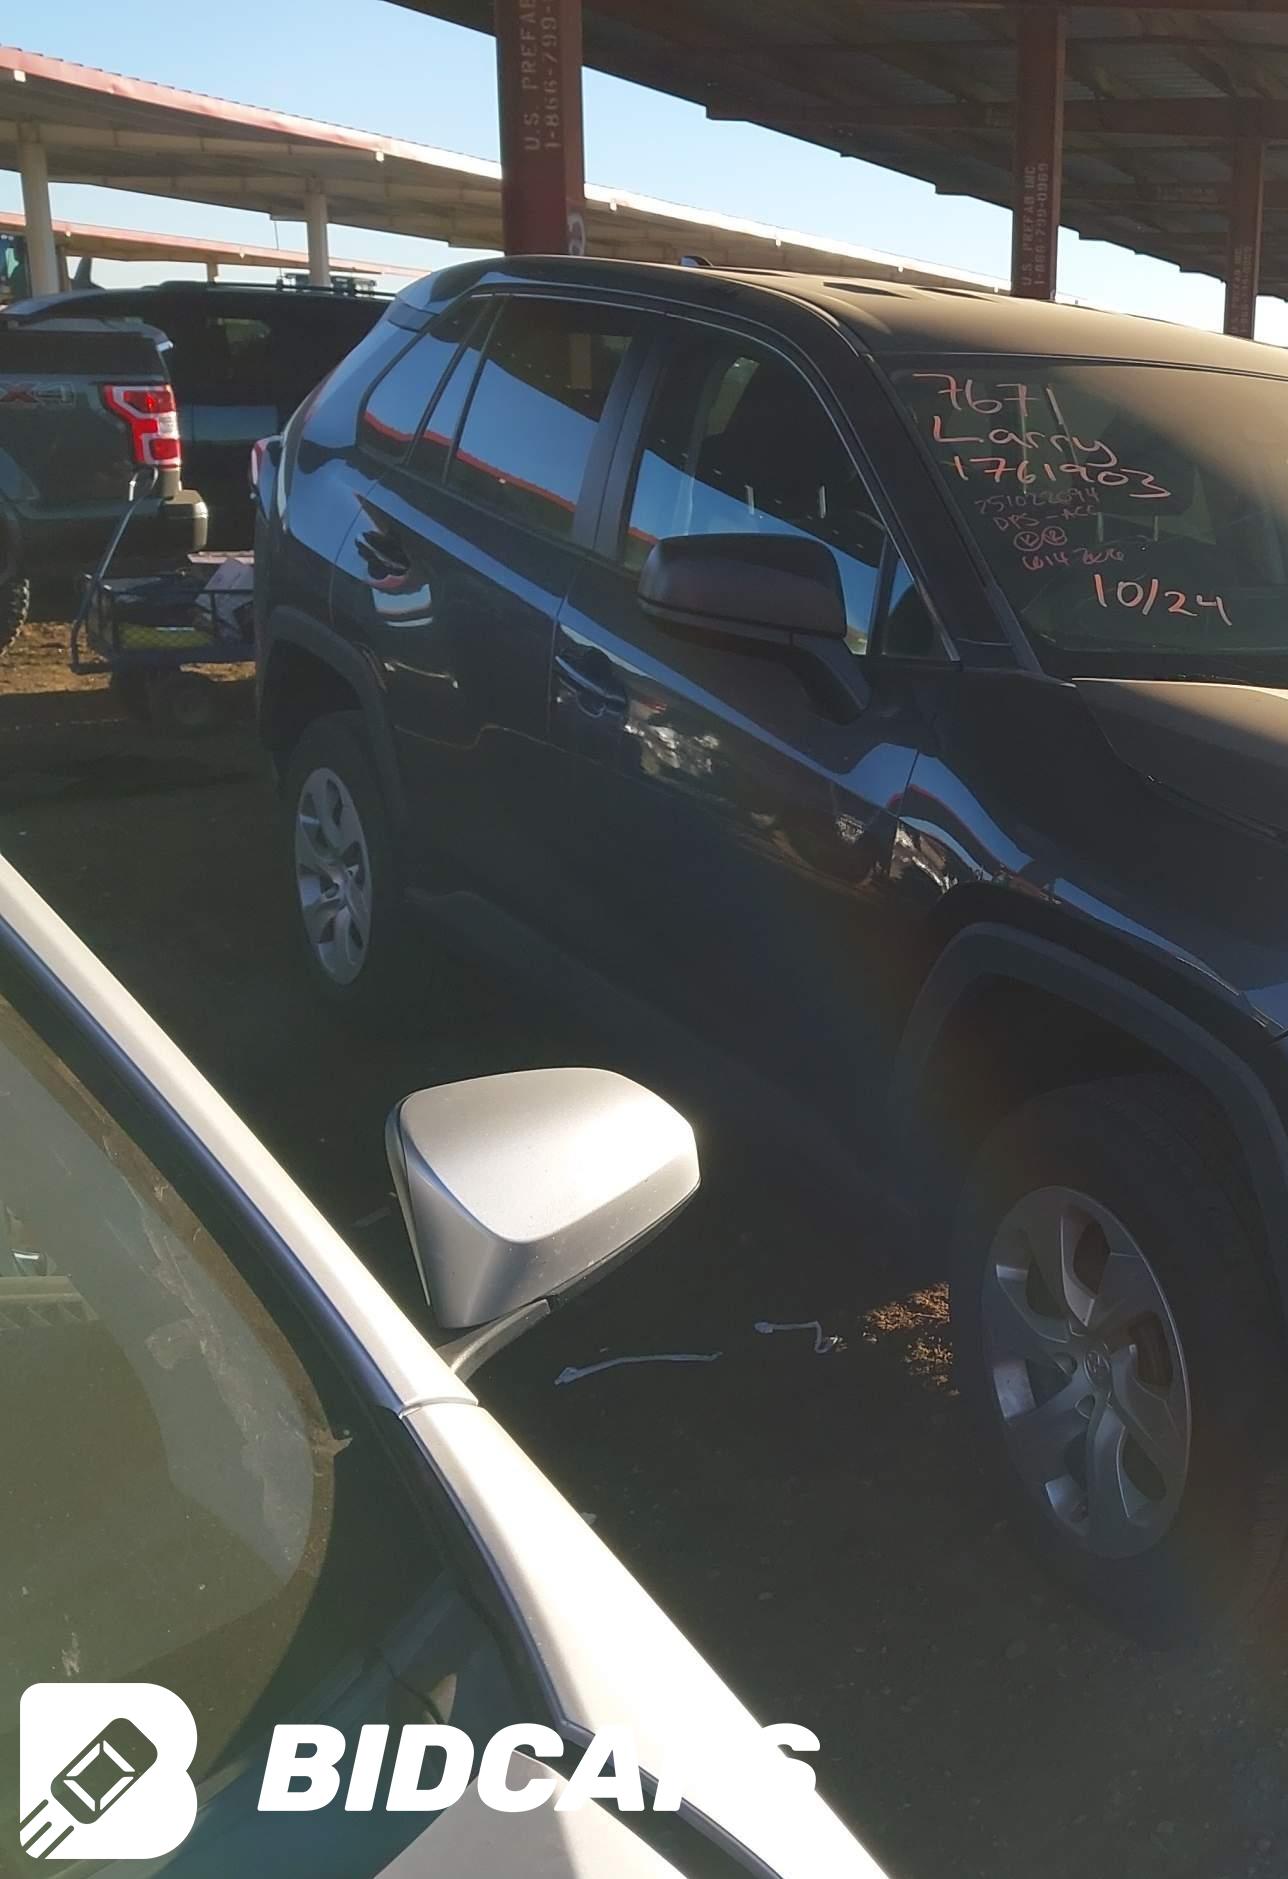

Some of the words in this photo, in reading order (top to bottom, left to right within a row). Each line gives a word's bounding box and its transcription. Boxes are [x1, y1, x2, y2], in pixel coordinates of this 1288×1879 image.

[541, 0, 561, 149] 1-866-799-
[934, 415, 1119, 468] Larry
[1094, 574, 1233, 627] 10/24
